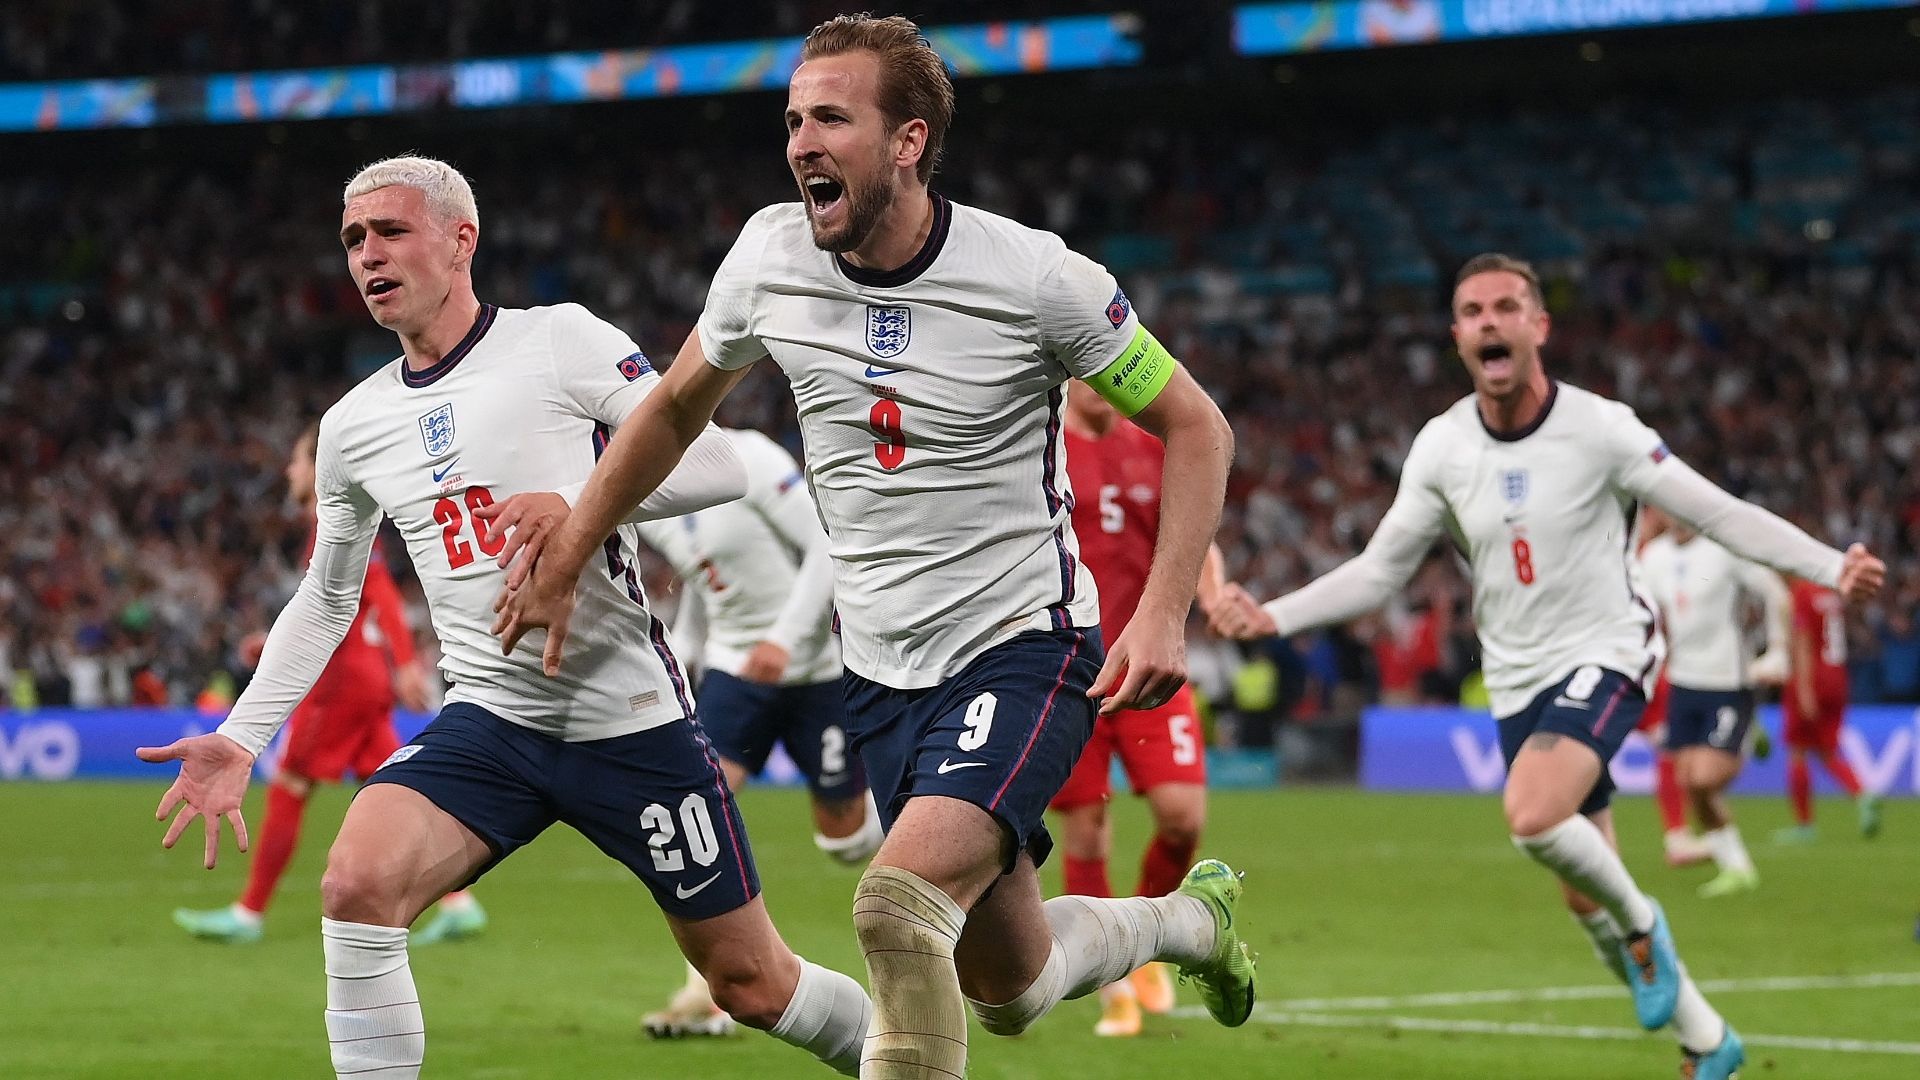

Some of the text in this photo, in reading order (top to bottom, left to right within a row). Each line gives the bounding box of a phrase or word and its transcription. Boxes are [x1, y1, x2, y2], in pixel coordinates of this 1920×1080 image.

[869, 399, 905, 470] 9
[432, 485, 507, 570] 20
[1100, 484, 1125, 533] 5
[1512, 538, 1535, 587] 8
[1565, 664, 1603, 702] 8
[820, 724, 846, 773] 2
[957, 691, 998, 752] 9
[1168, 713, 1198, 767] 5
[639, 792, 720, 872] 20
